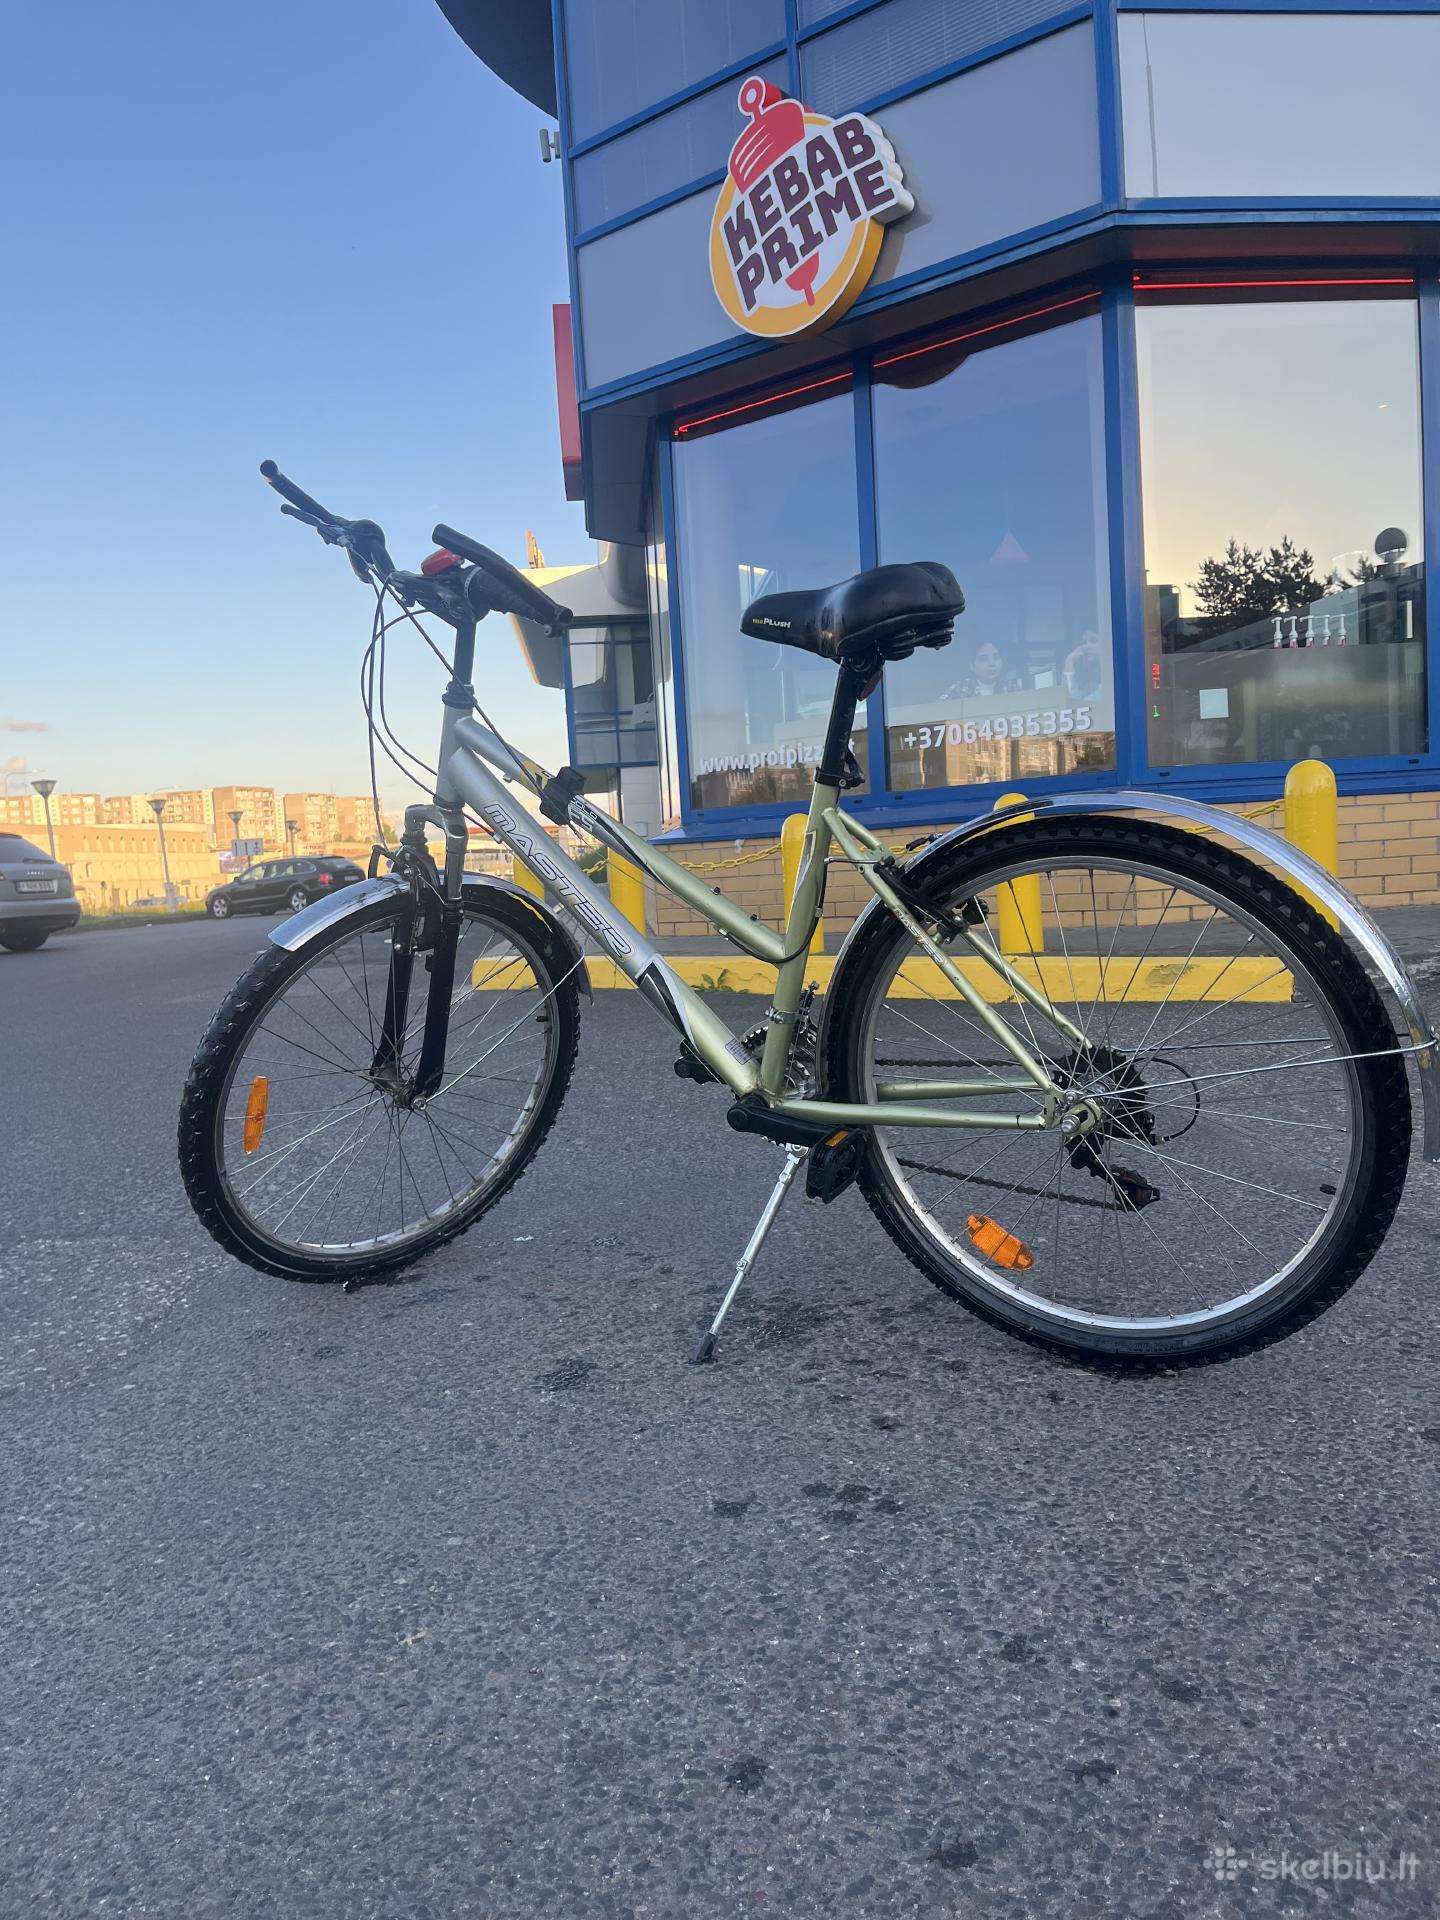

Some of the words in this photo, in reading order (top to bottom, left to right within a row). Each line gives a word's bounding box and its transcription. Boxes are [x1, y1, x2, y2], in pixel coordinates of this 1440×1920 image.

[723, 118, 876, 267] KEBAB
[736, 160, 895, 311] PRIME
[700, 738, 855, 773] www.profpizzt
[904, 706, 1092, 749] +37064935355
[484, 803, 632, 958] MASTER
